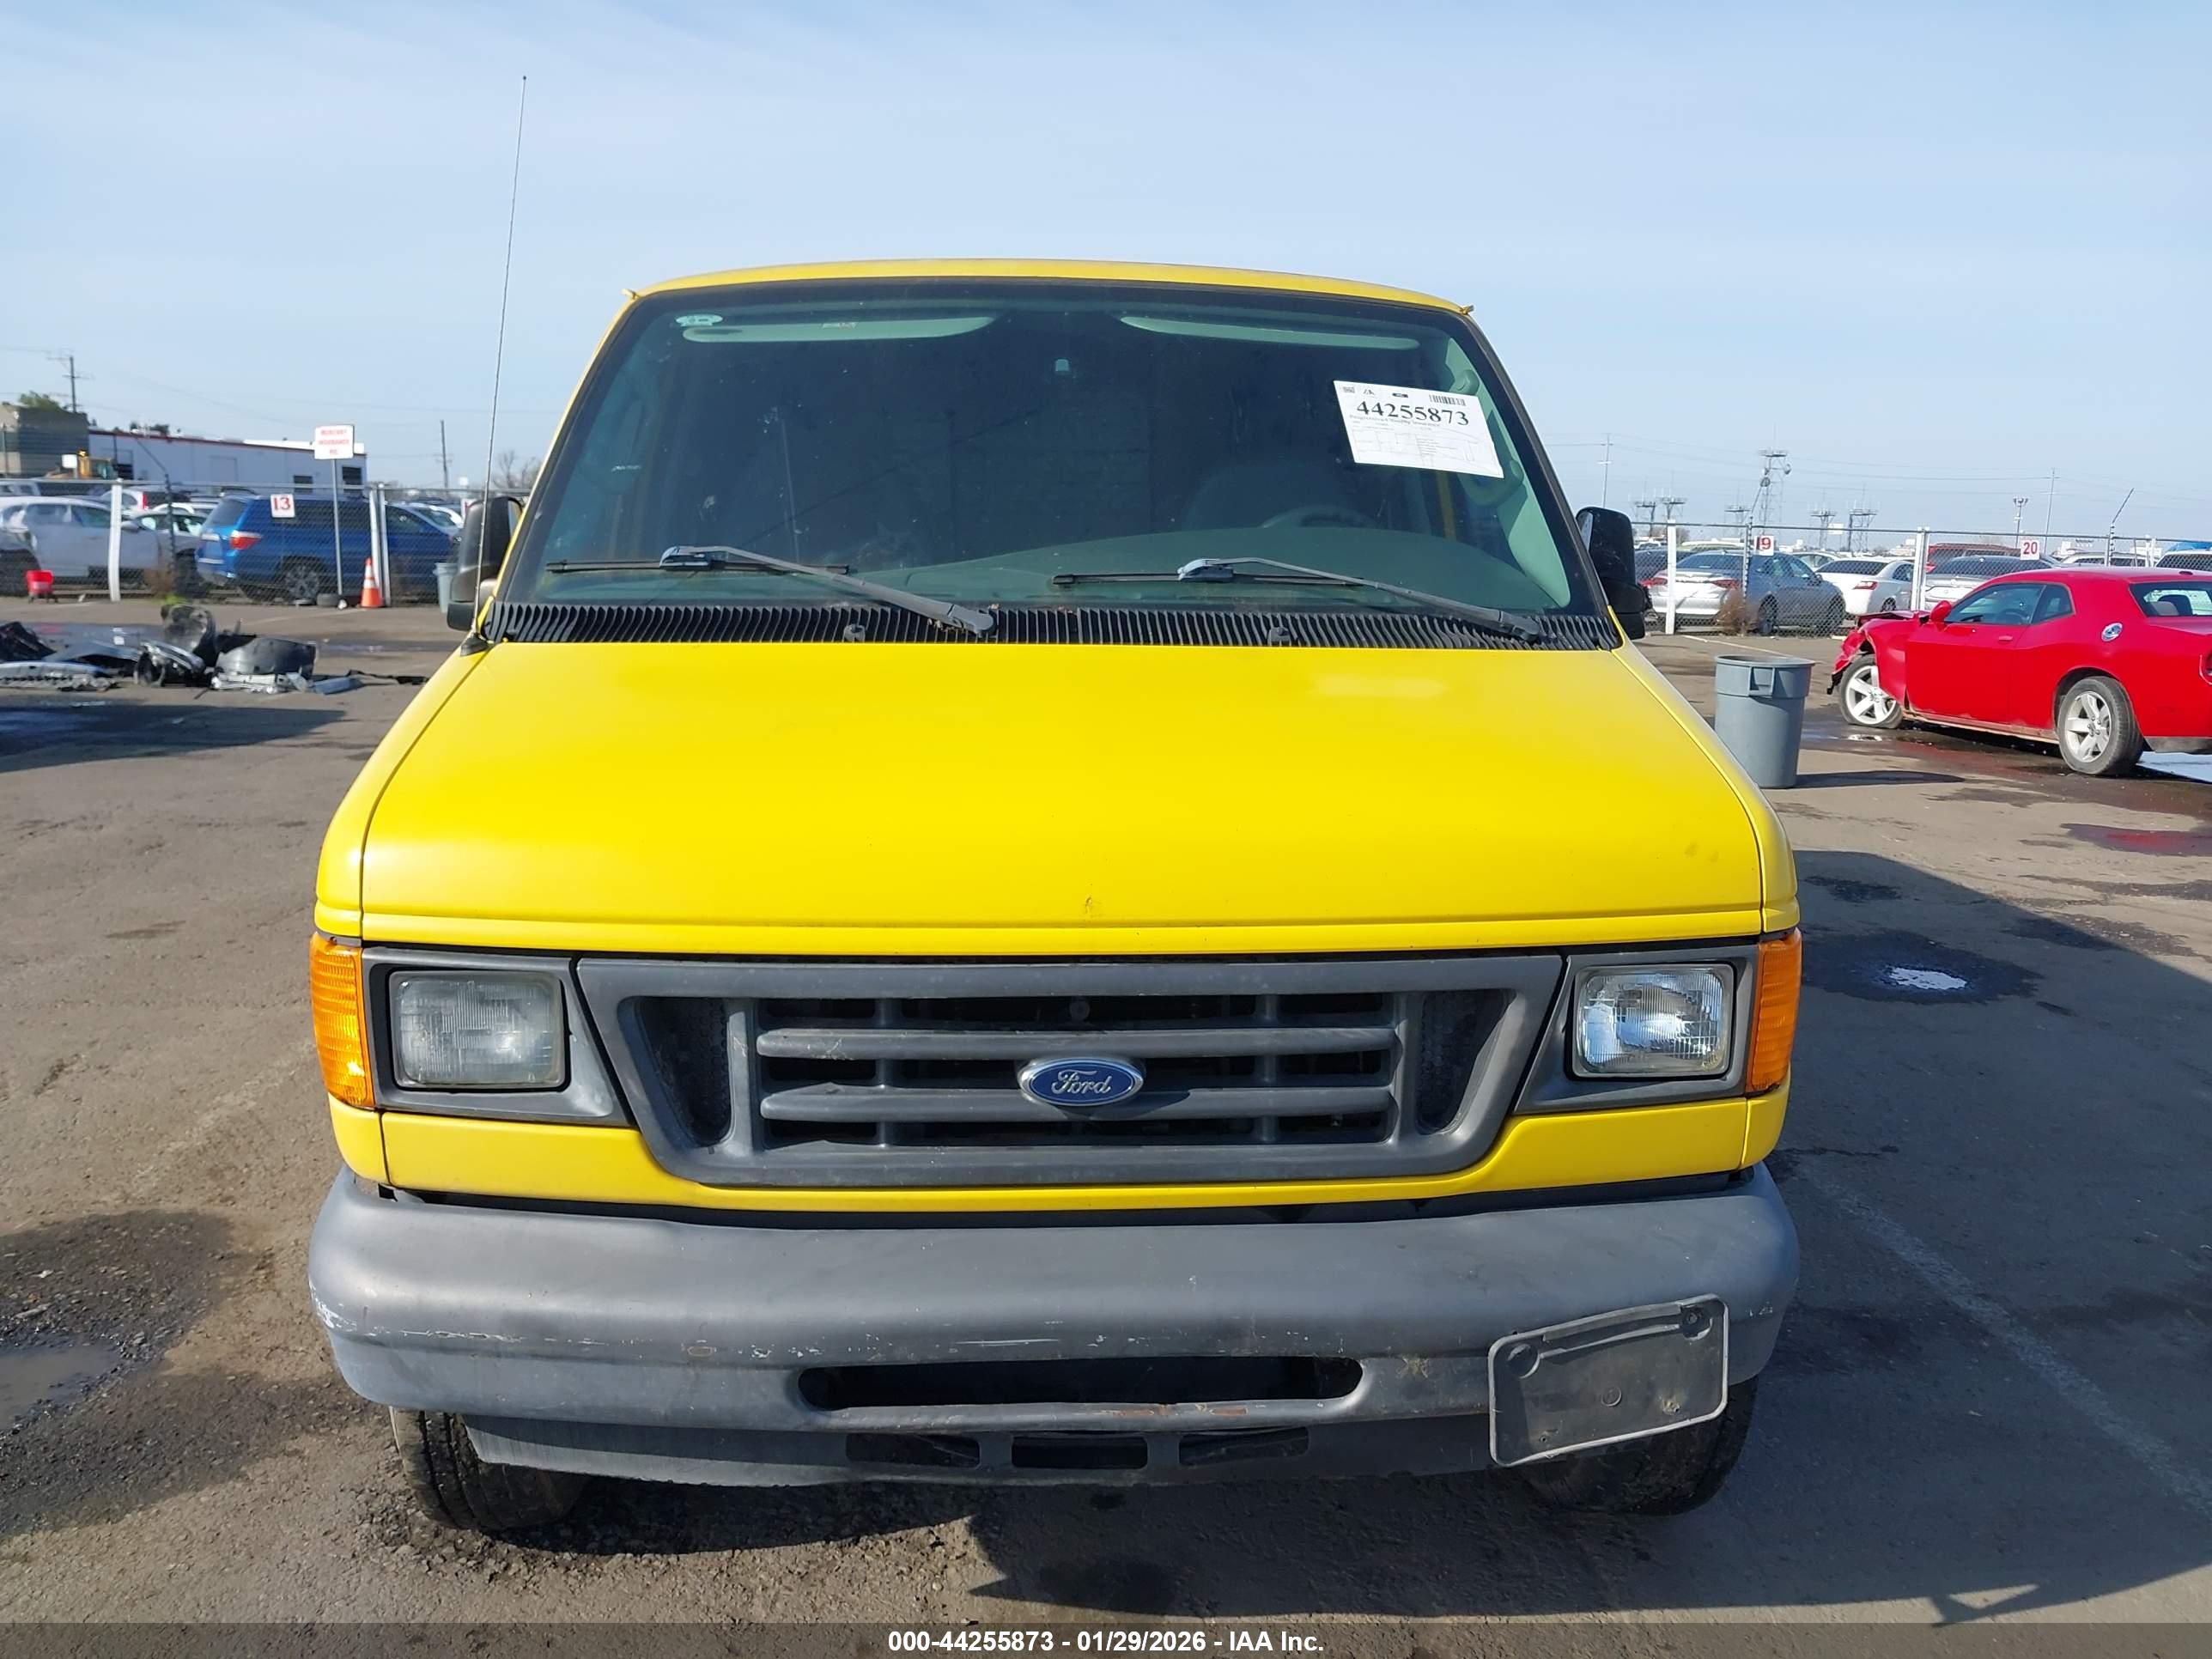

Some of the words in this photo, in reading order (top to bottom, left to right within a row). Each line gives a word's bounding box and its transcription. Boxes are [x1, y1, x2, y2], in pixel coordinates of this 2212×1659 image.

[1357, 401, 1468, 425] 44255873
[274, 497, 291, 511] 13
[1756, 537, 1771, 550] 19
[2023, 541, 2038, 555] 20
[1051, 1069, 1113, 1095] Ford
